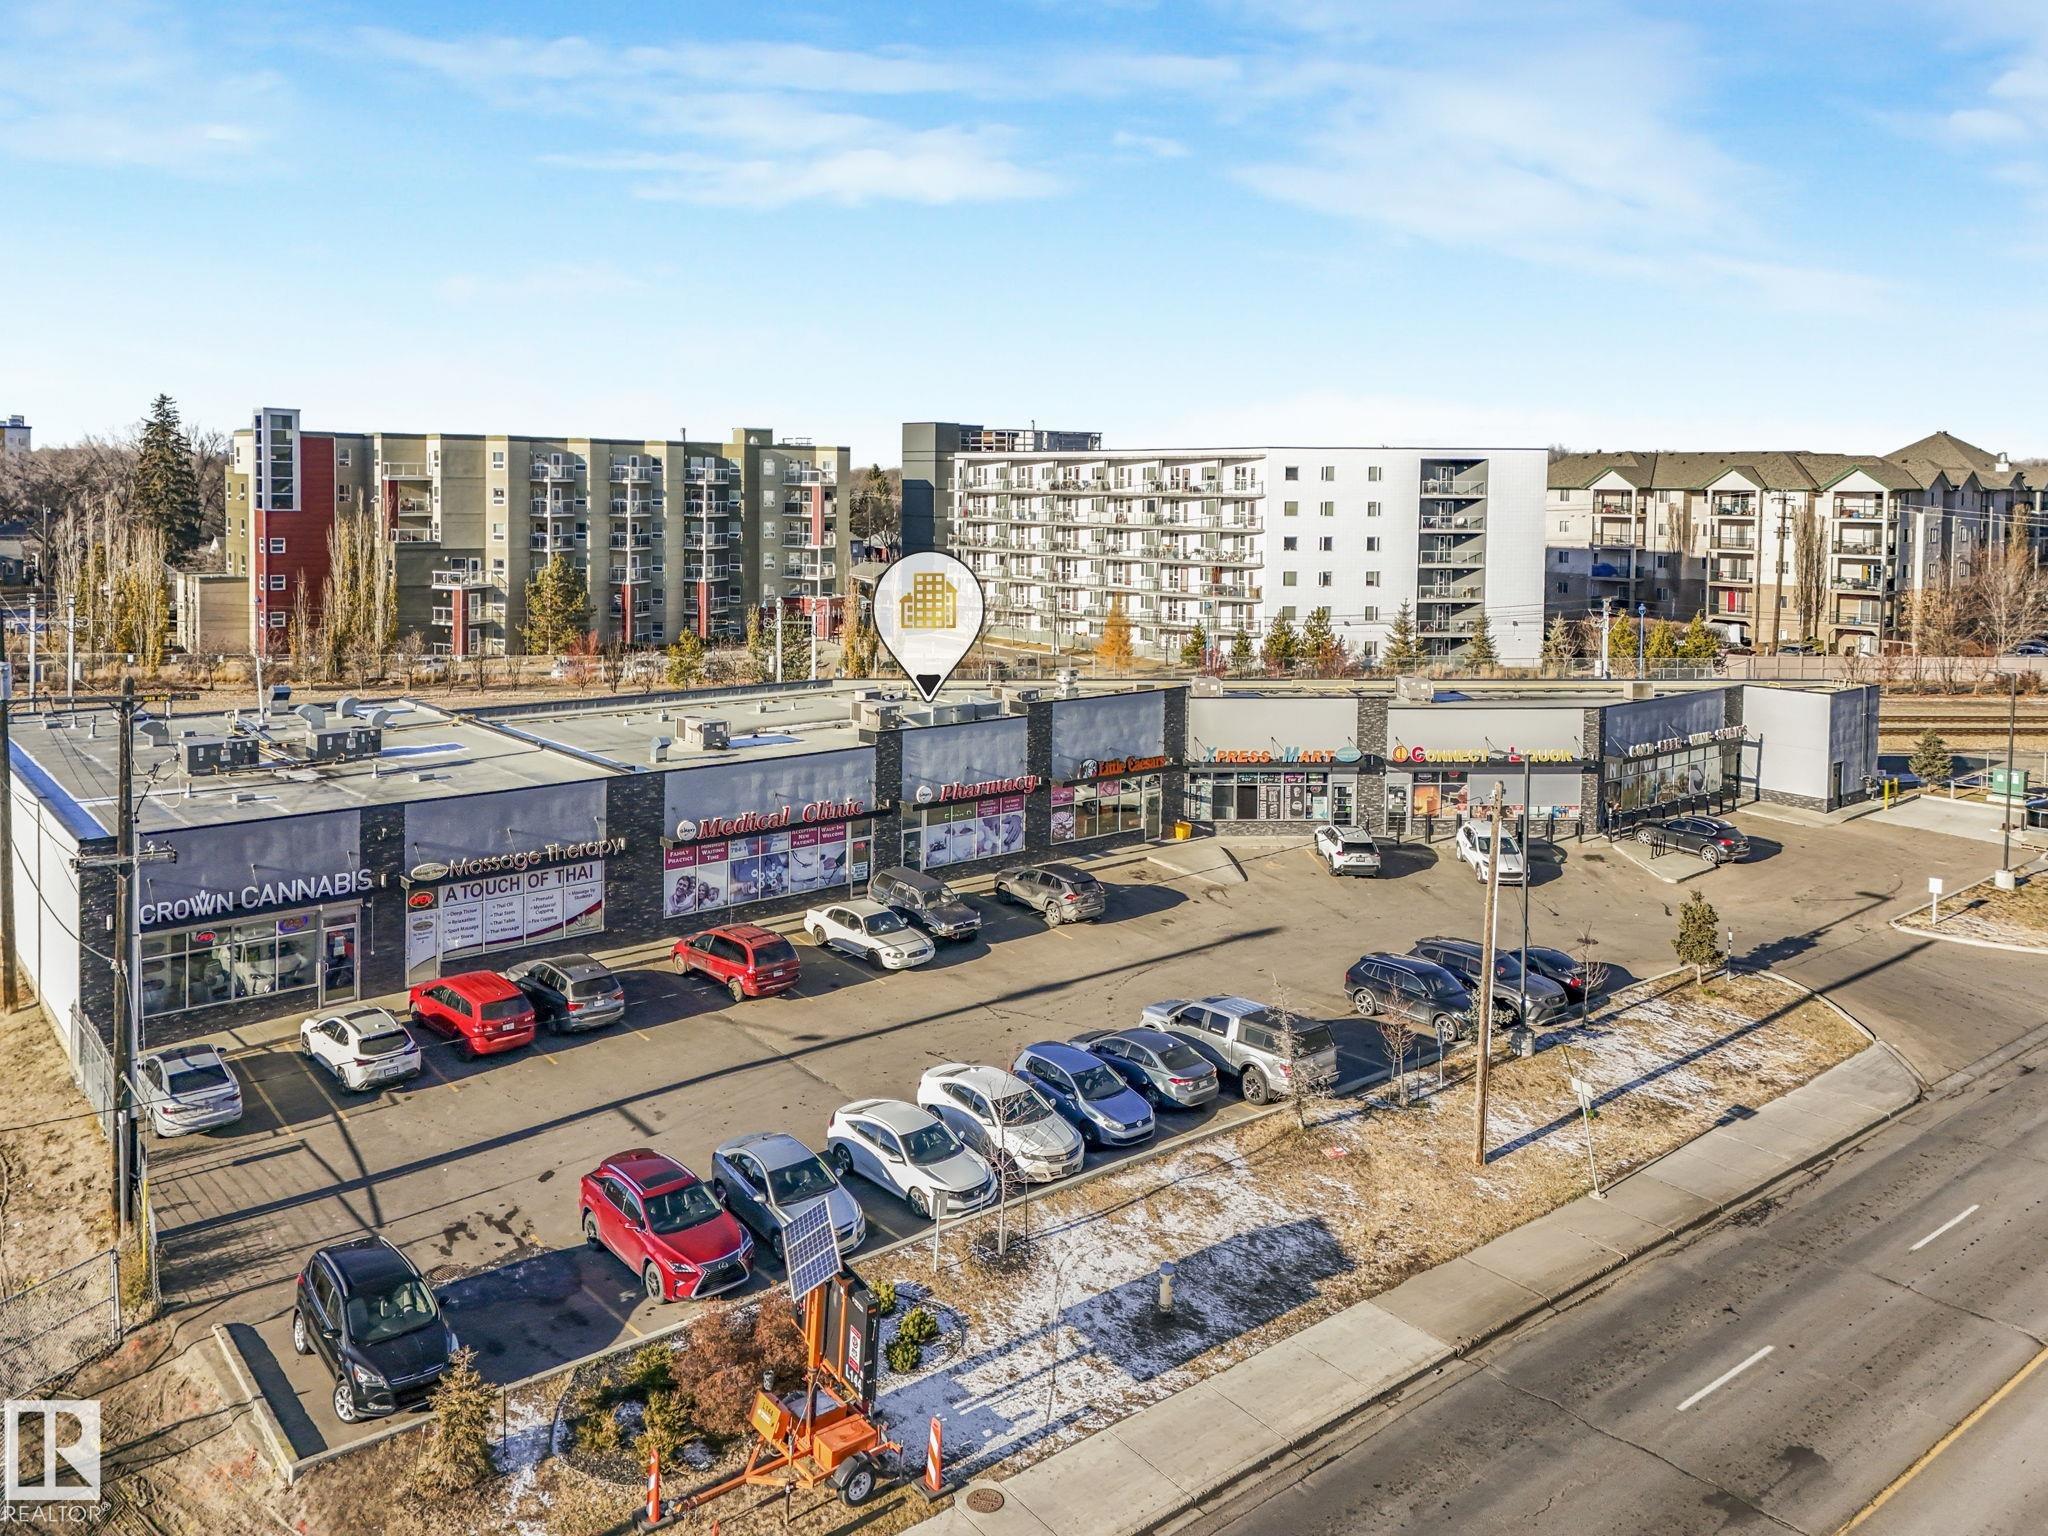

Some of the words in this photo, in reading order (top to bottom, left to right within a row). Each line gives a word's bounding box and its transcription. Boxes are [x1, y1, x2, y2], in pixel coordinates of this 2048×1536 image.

[1204, 746, 1271, 763] XPRESS
[1282, 746, 1335, 763] MART
[1410, 746, 1489, 763] CONNECT
[939, 774, 1036, 803] Pharmacy
[697, 806, 791, 840] Medical
[802, 798, 865, 823] Clinic
[449, 849, 542, 878] Massage
[545, 838, 621, 861] Therapy
[139, 889, 234, 926] CROWN
[241, 868, 374, 909] CANNABIS
[445, 886, 458, 903] A
[460, 876, 520, 900] TOUCH
[528, 872, 549, 888] OF
[555, 864, 593, 884] THAI
